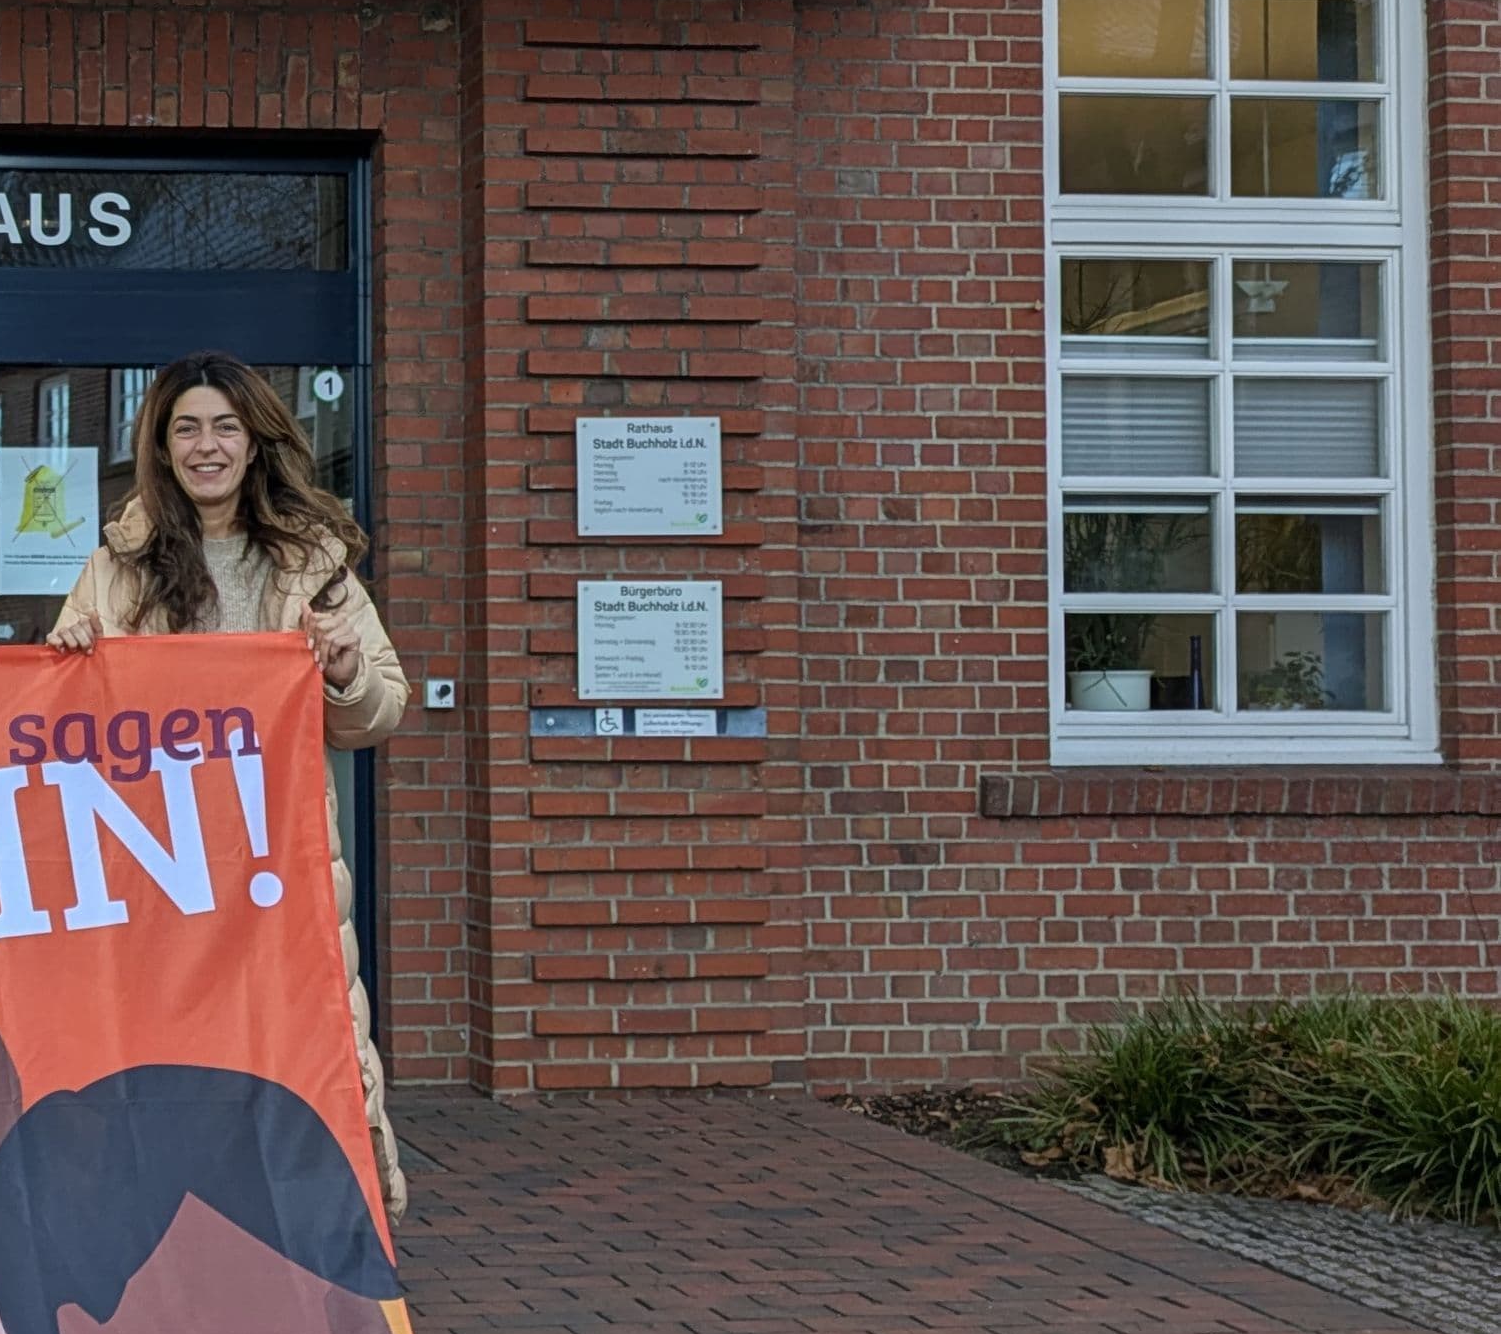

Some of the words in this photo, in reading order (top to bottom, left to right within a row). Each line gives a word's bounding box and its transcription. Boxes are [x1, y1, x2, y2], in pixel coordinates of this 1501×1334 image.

[324, 376, 333, 396] 1
[627, 423, 673, 434] Rathaus
[593, 438, 624, 449] Stadt
[626, 438, 677, 449] Buchholz
[620, 586, 683, 599] Bürgerbüro
[594, 601, 625, 612] Stadt
[628, 601, 679, 612] Buchholz
[9, 705, 262, 782] sagen
